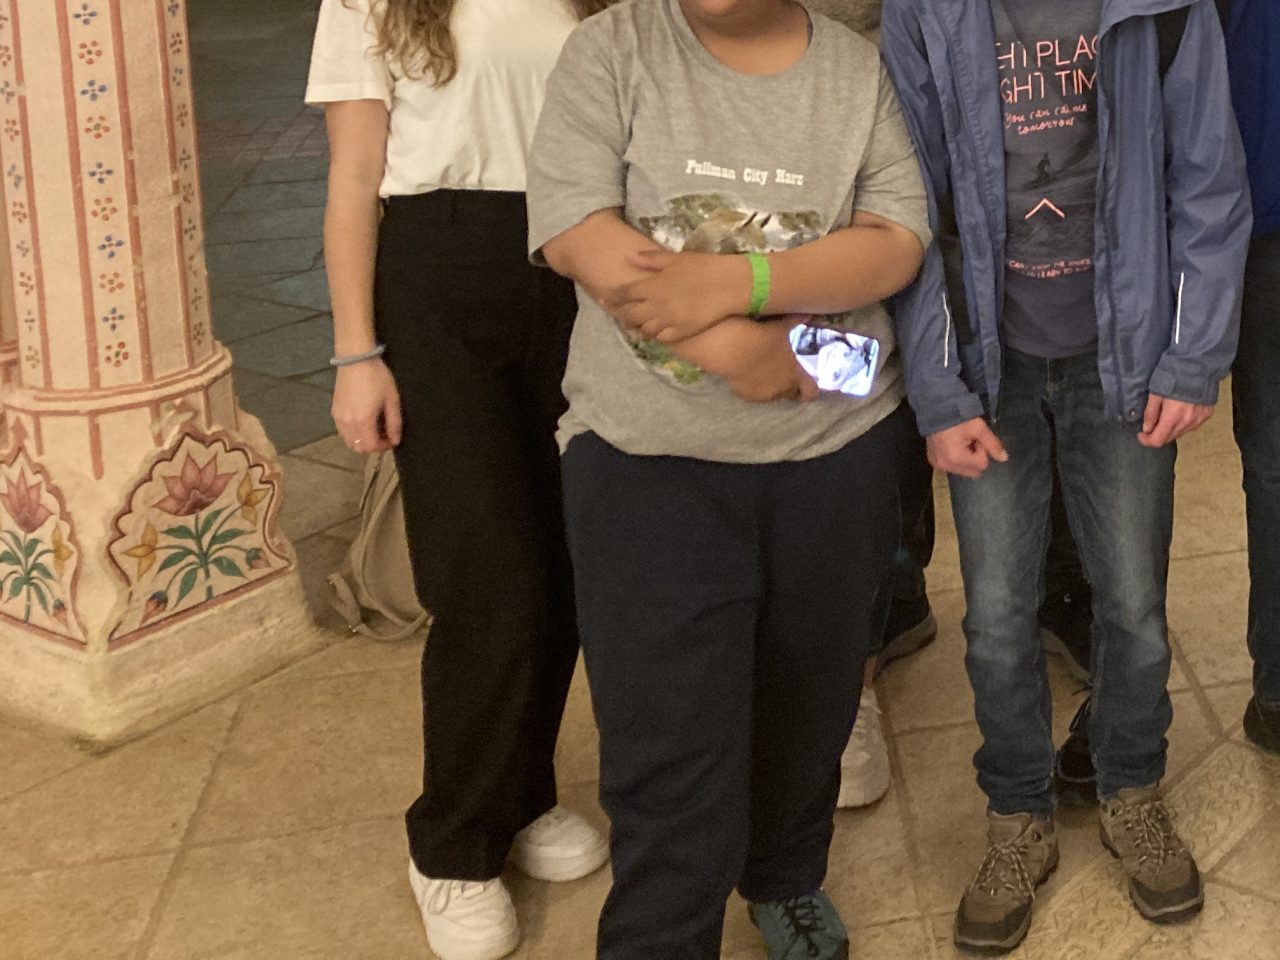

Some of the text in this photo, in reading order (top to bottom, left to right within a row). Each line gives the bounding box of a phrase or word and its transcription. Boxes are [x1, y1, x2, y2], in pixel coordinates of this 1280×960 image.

[685, 159, 804, 186] Pullman City Harz
